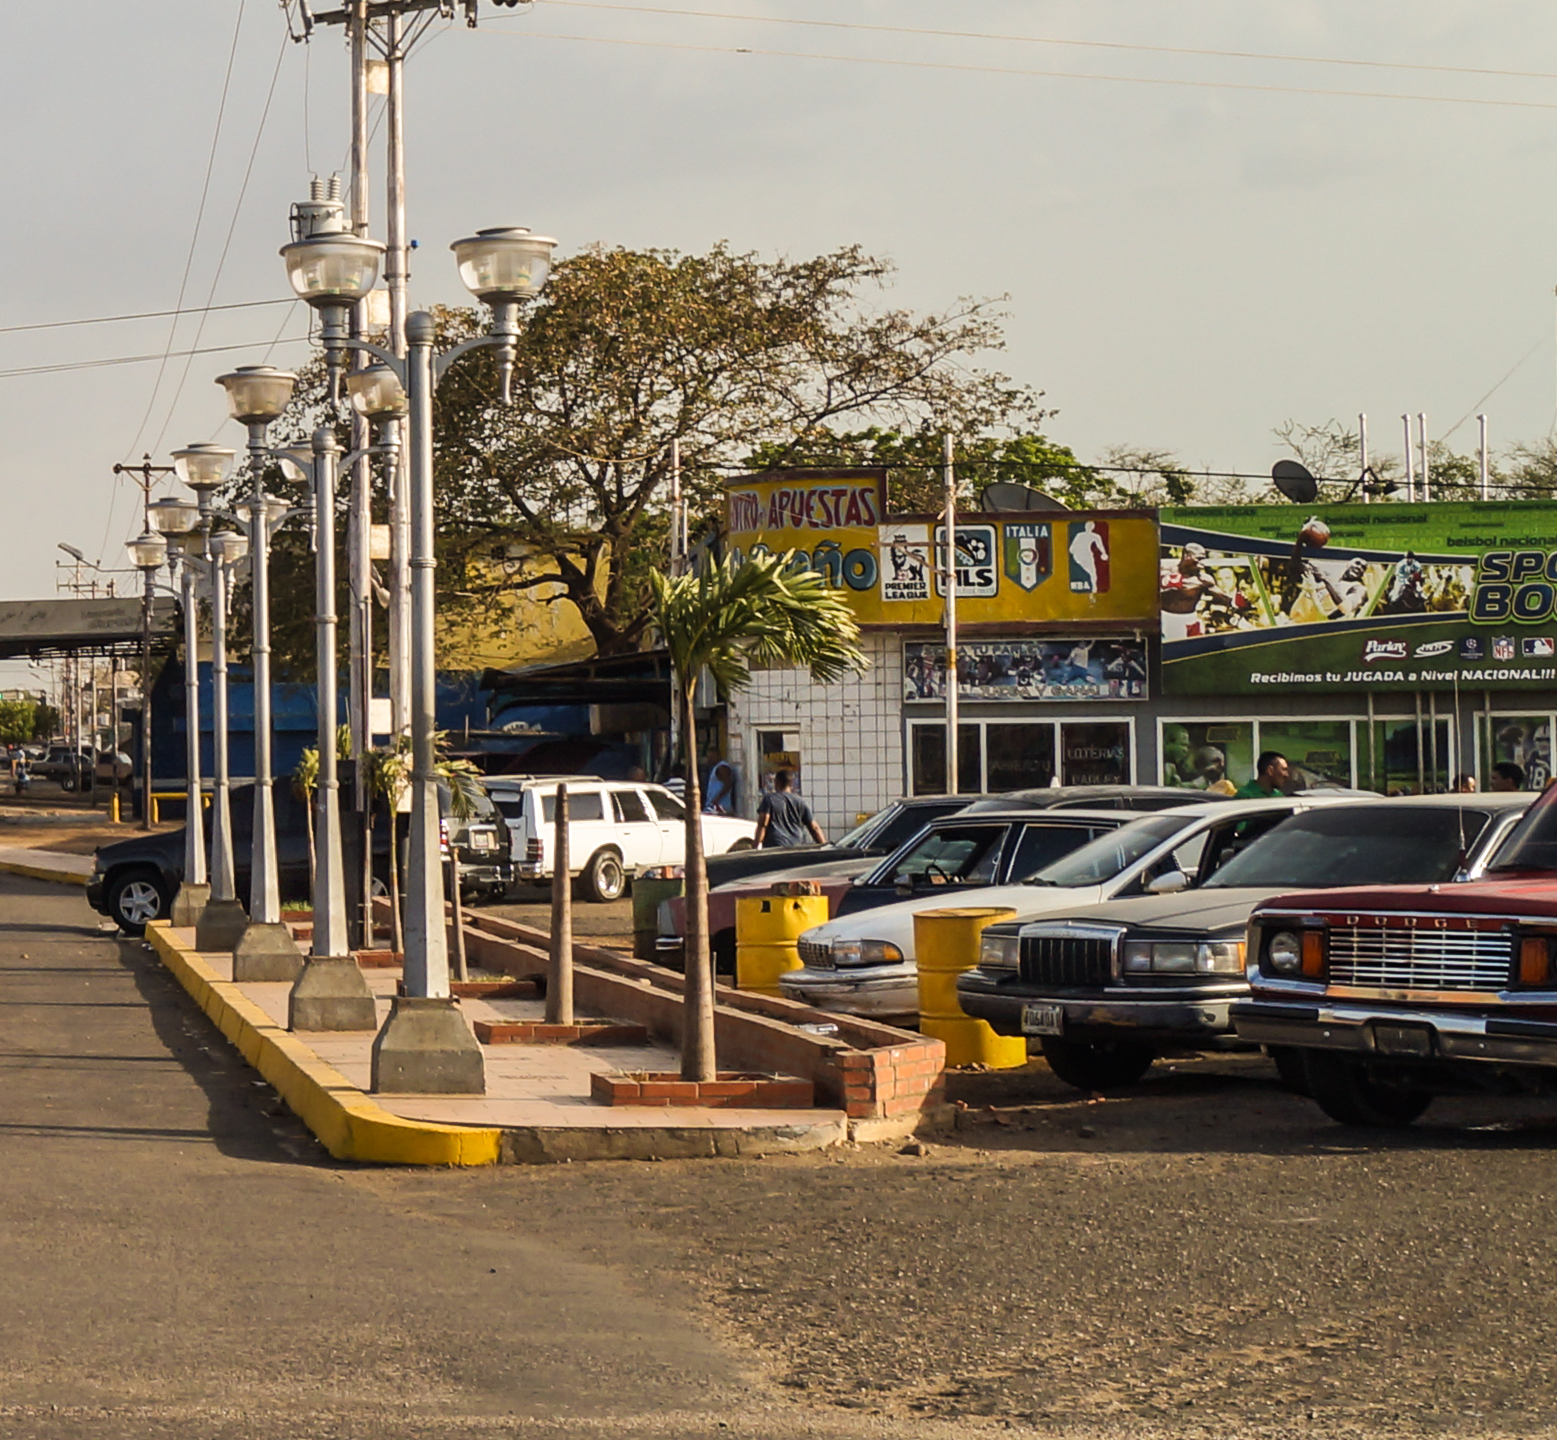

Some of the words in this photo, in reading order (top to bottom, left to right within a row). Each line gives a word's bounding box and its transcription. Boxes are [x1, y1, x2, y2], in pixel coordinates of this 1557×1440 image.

[767, 487, 876, 529] APUESTAS
[1006, 525, 1048, 537] ITALIA
[885, 581, 926, 590] PREMIER
[1070, 580, 1090, 590] NBA
[885, 591, 928, 599] LEAGUE
[1472, 582, 1557, 620] BO
[1494, 647, 1514, 657] NFL
[1250, 672, 1322, 683] Recibimos
[1326, 672, 1341, 682] tu
[1344, 671, 1404, 682] JUGADA
[1408, 673, 1417, 681] a
[1421, 670, 1458, 681] Nivel
[1461, 668, 1556, 681] NACIONAL!!!
[1347, 915, 1479, 929] DODGE
